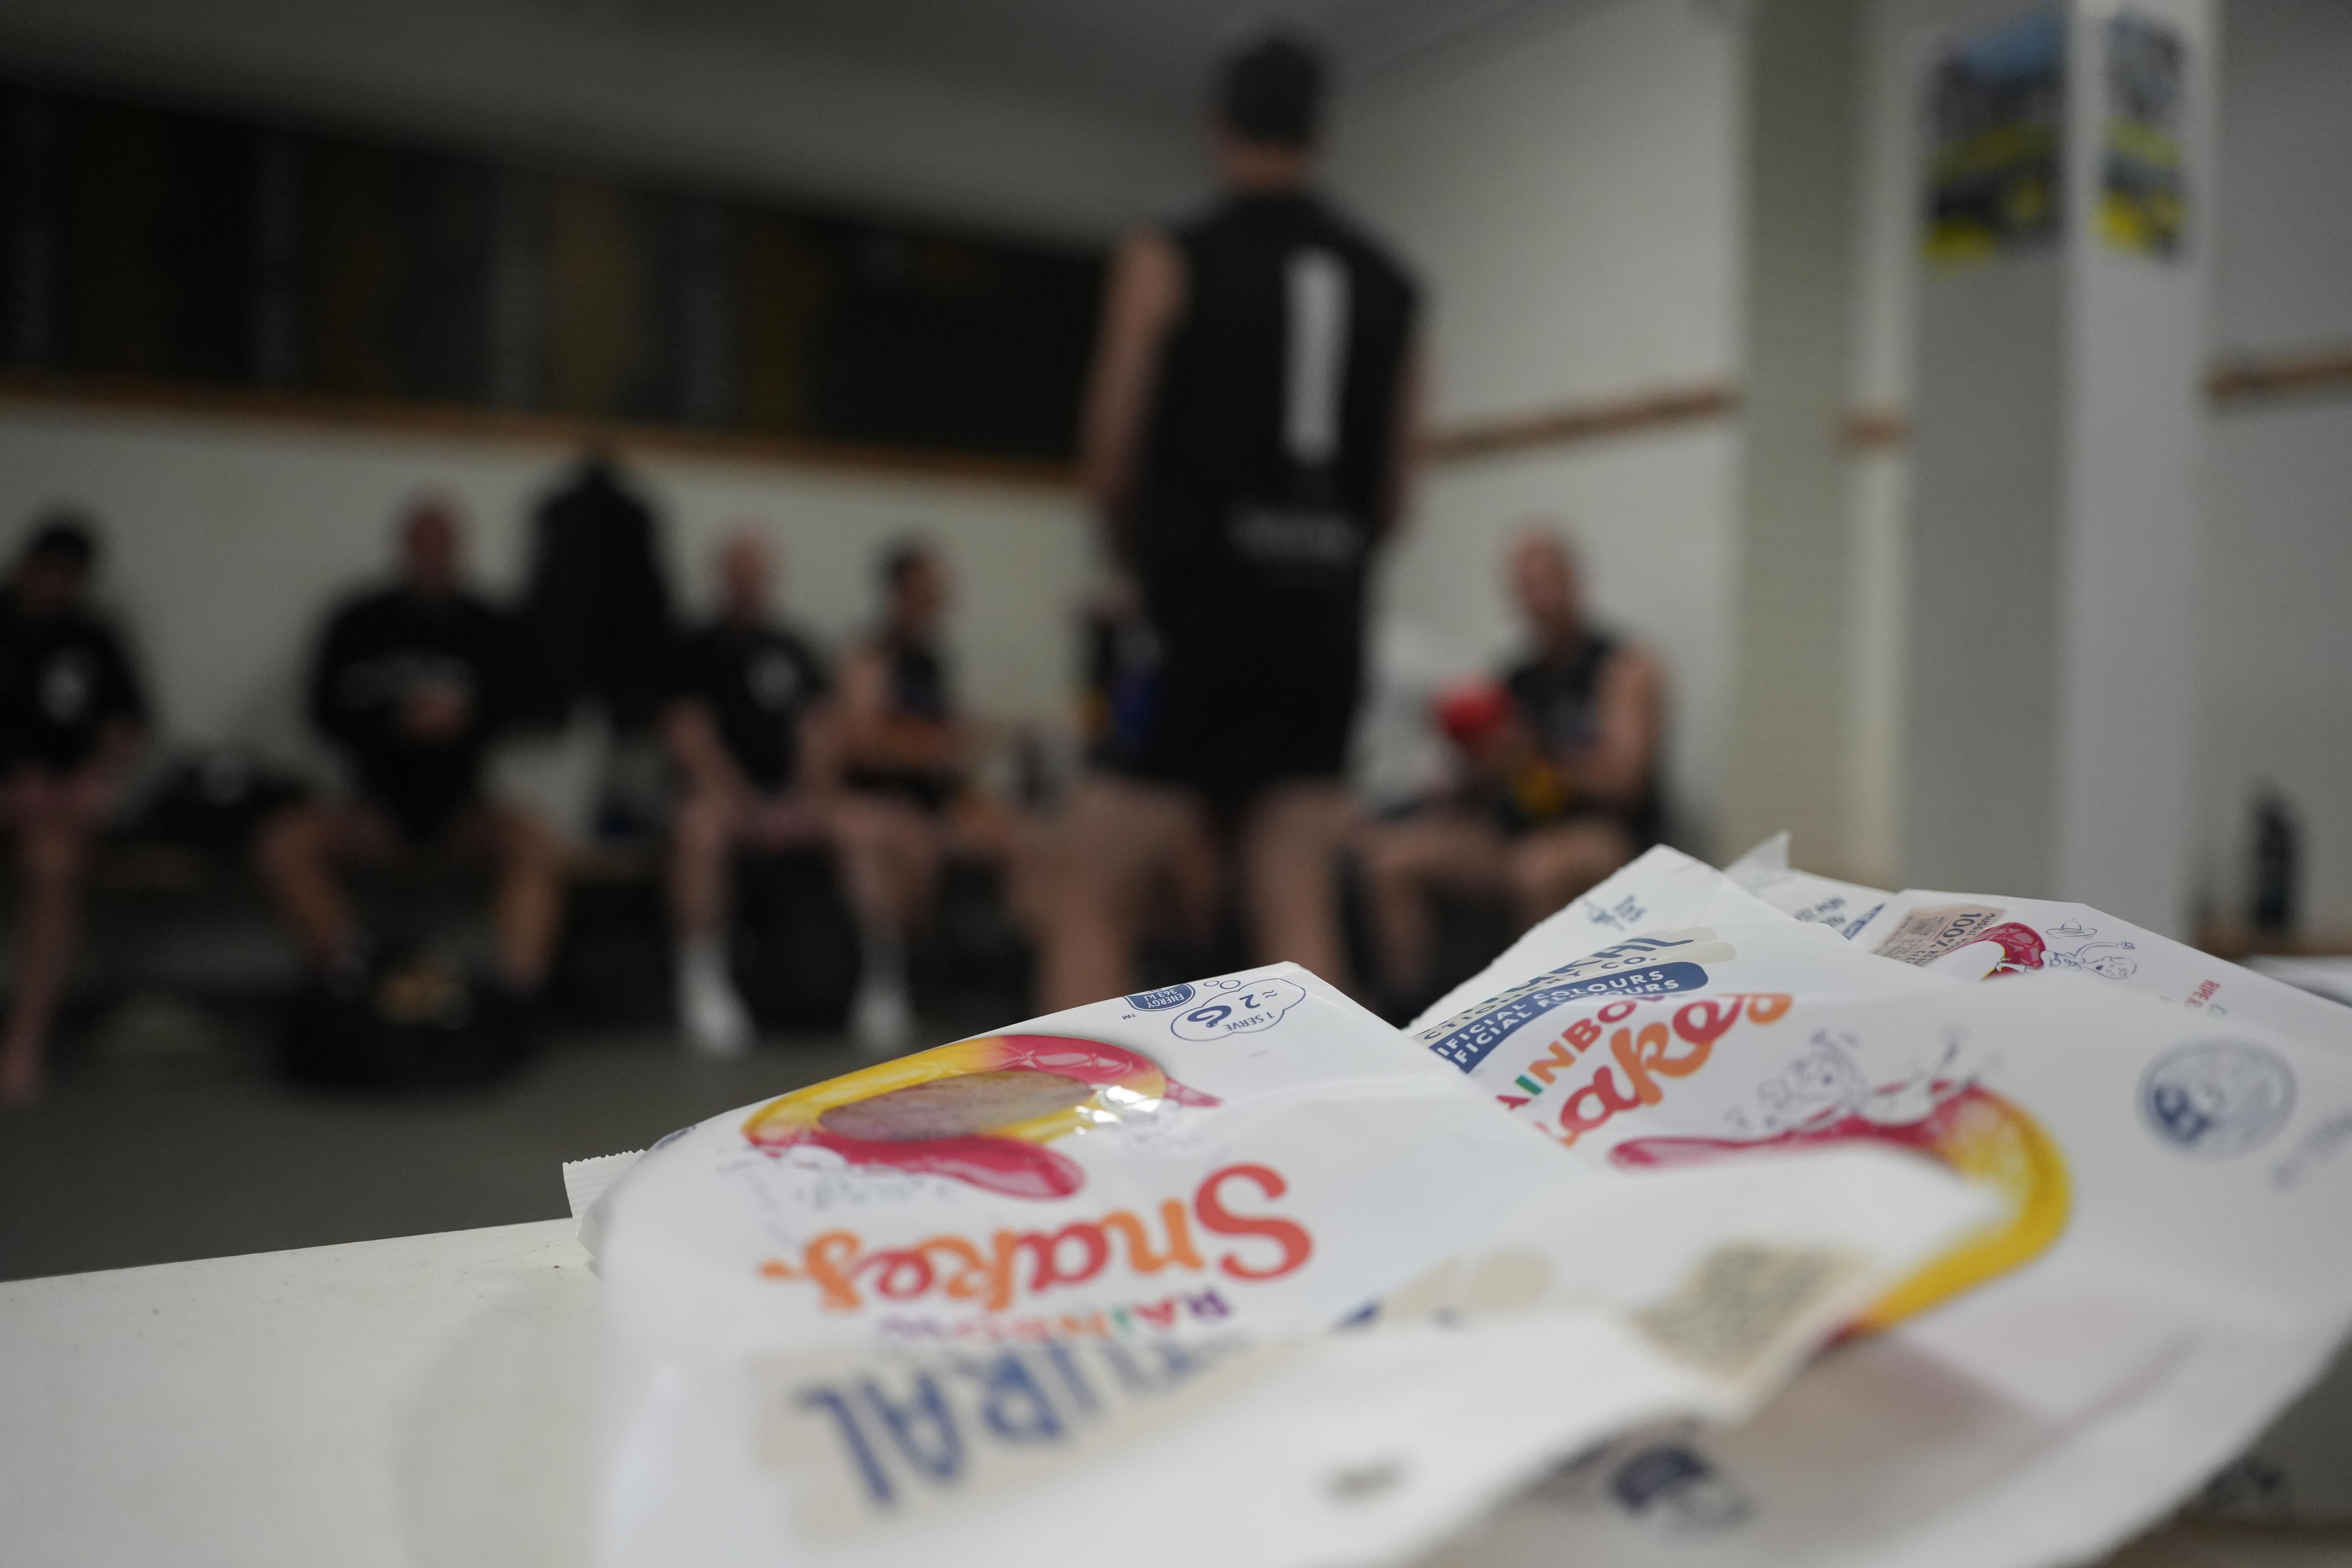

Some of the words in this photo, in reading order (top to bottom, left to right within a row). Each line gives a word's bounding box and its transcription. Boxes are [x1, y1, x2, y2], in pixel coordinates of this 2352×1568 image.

[1930, 913, 1982, 948] 100%
[1147, 994, 1185, 1009] ENERGY
[1156, 987, 1177, 997] 363
[1239, 994, 1261, 1009] 2
[1423, 969, 1581, 1040] CTIONERY
[1600, 956, 1657, 970] CO.
[1223, 1014, 1264, 1032] SERVE
[1436, 1003, 1527, 1057] IFICIAL
[1532, 970, 1664, 1000] COLOURS
[1454, 1011, 1533, 1064] FICIAL
